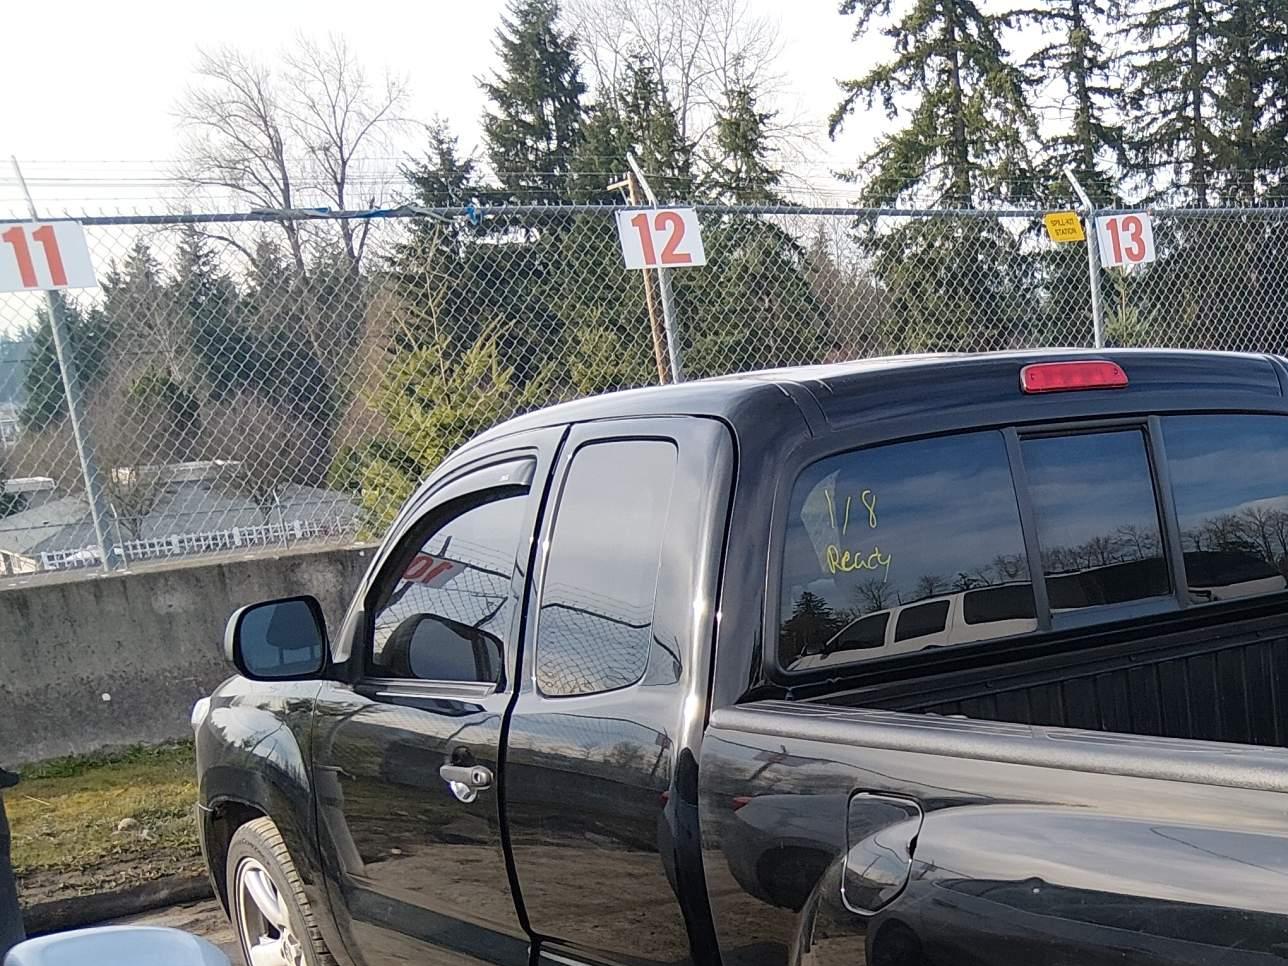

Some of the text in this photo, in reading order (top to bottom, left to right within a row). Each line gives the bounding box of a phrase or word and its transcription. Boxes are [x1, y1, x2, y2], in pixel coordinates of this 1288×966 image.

[2, 225, 67, 288] 11
[631, 211, 692, 265] 12
[1106, 215, 1146, 263] 13
[826, 545, 892, 583] Ready
